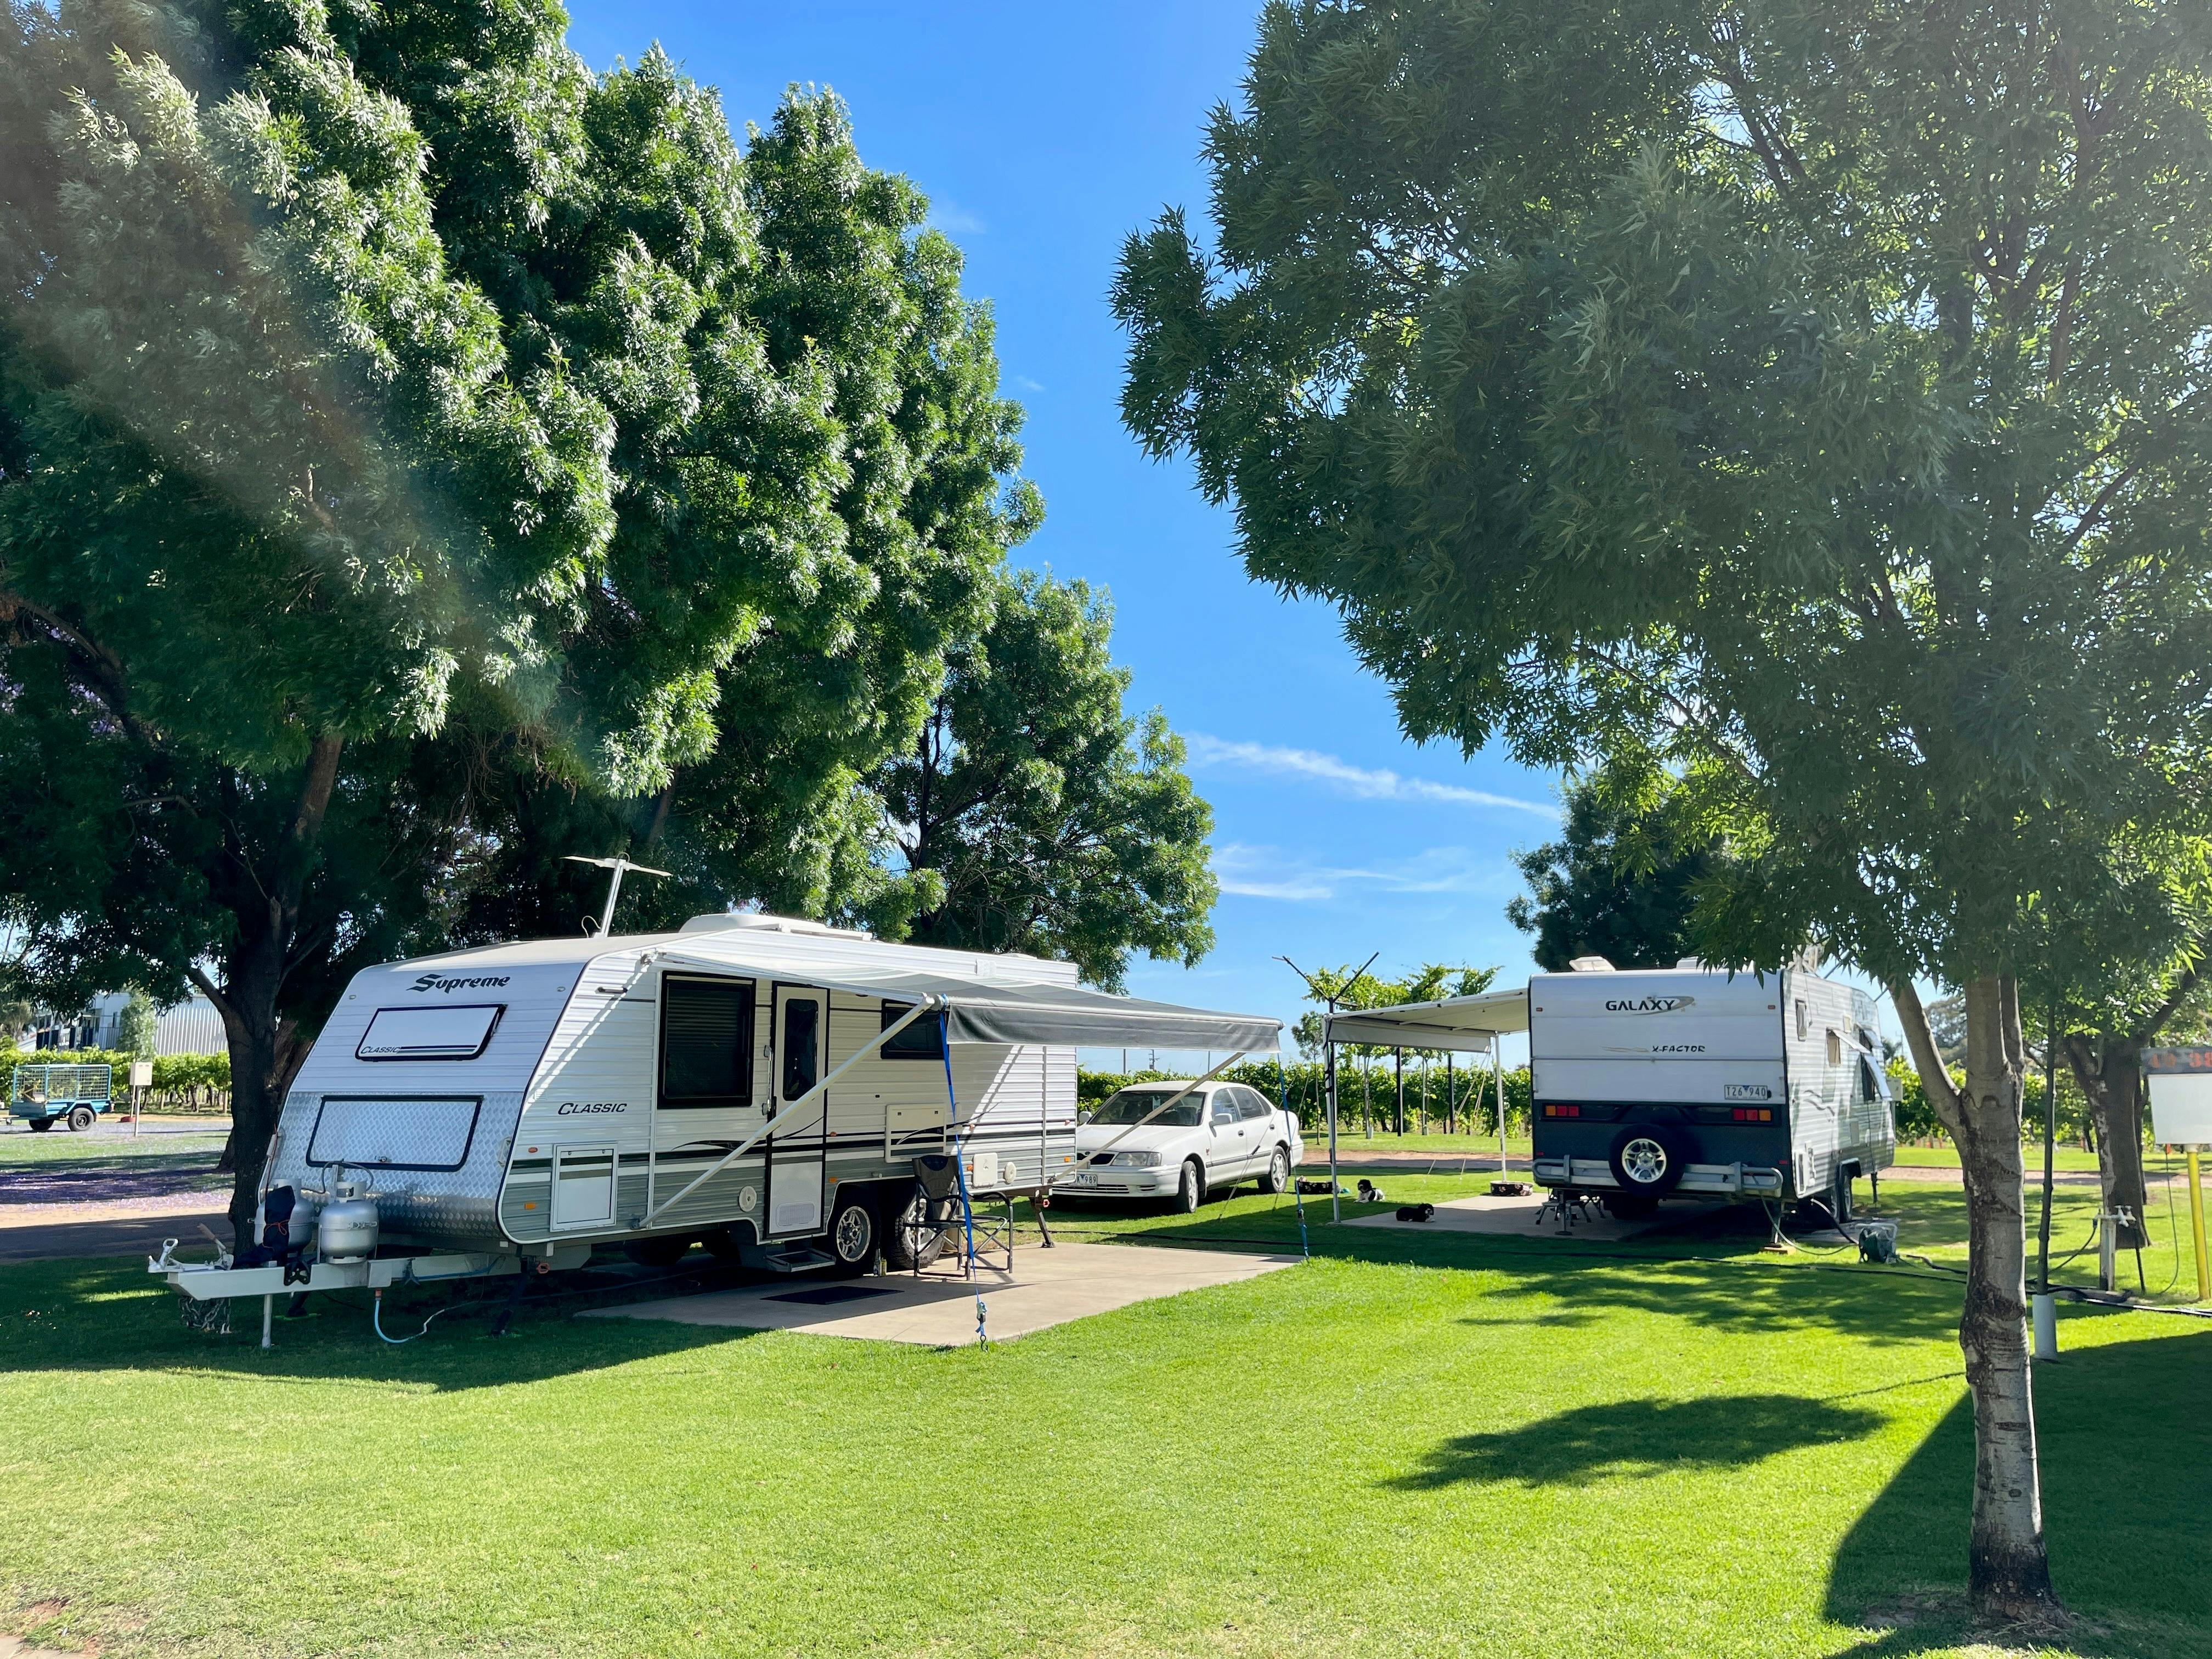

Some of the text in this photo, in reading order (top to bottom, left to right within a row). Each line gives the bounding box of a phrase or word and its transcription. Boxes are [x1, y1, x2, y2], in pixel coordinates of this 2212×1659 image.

[406, 974, 511, 994] Supreme
[1605, 1000, 1675, 1011] GALAXY
[1726, 1087, 1766, 1096] T26 940
[558, 1103, 627, 1115] CLASSIC
[1085, 1176, 1096, 1184] 989
